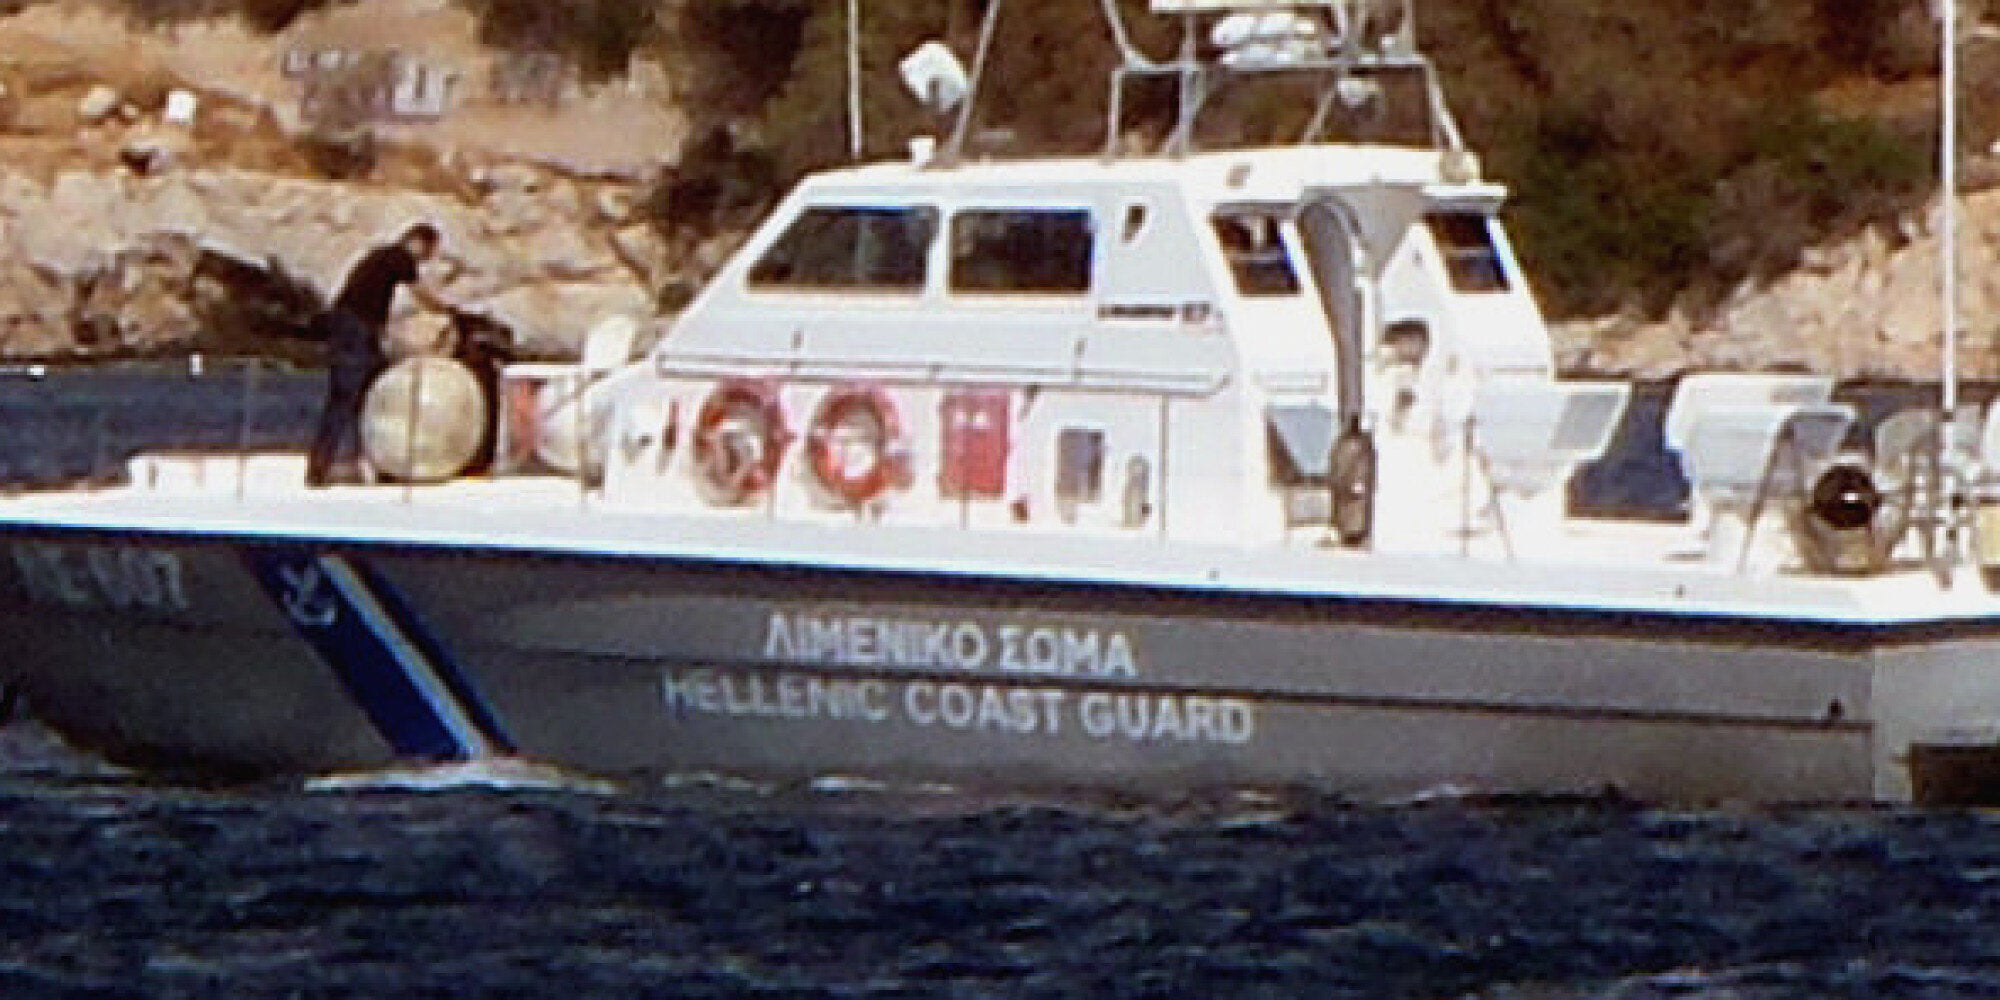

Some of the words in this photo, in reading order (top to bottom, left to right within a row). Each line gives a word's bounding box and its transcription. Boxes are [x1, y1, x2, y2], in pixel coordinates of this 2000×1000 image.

[763, 612, 987, 670] ΛΙΜΕΝΙΚΟ
[999, 623, 1138, 678] ΣΩΜΑ
[664, 669, 888, 721] HELLENIC
[904, 680, 1065, 735] COAST
[1080, 692, 1253, 744] GUARD
